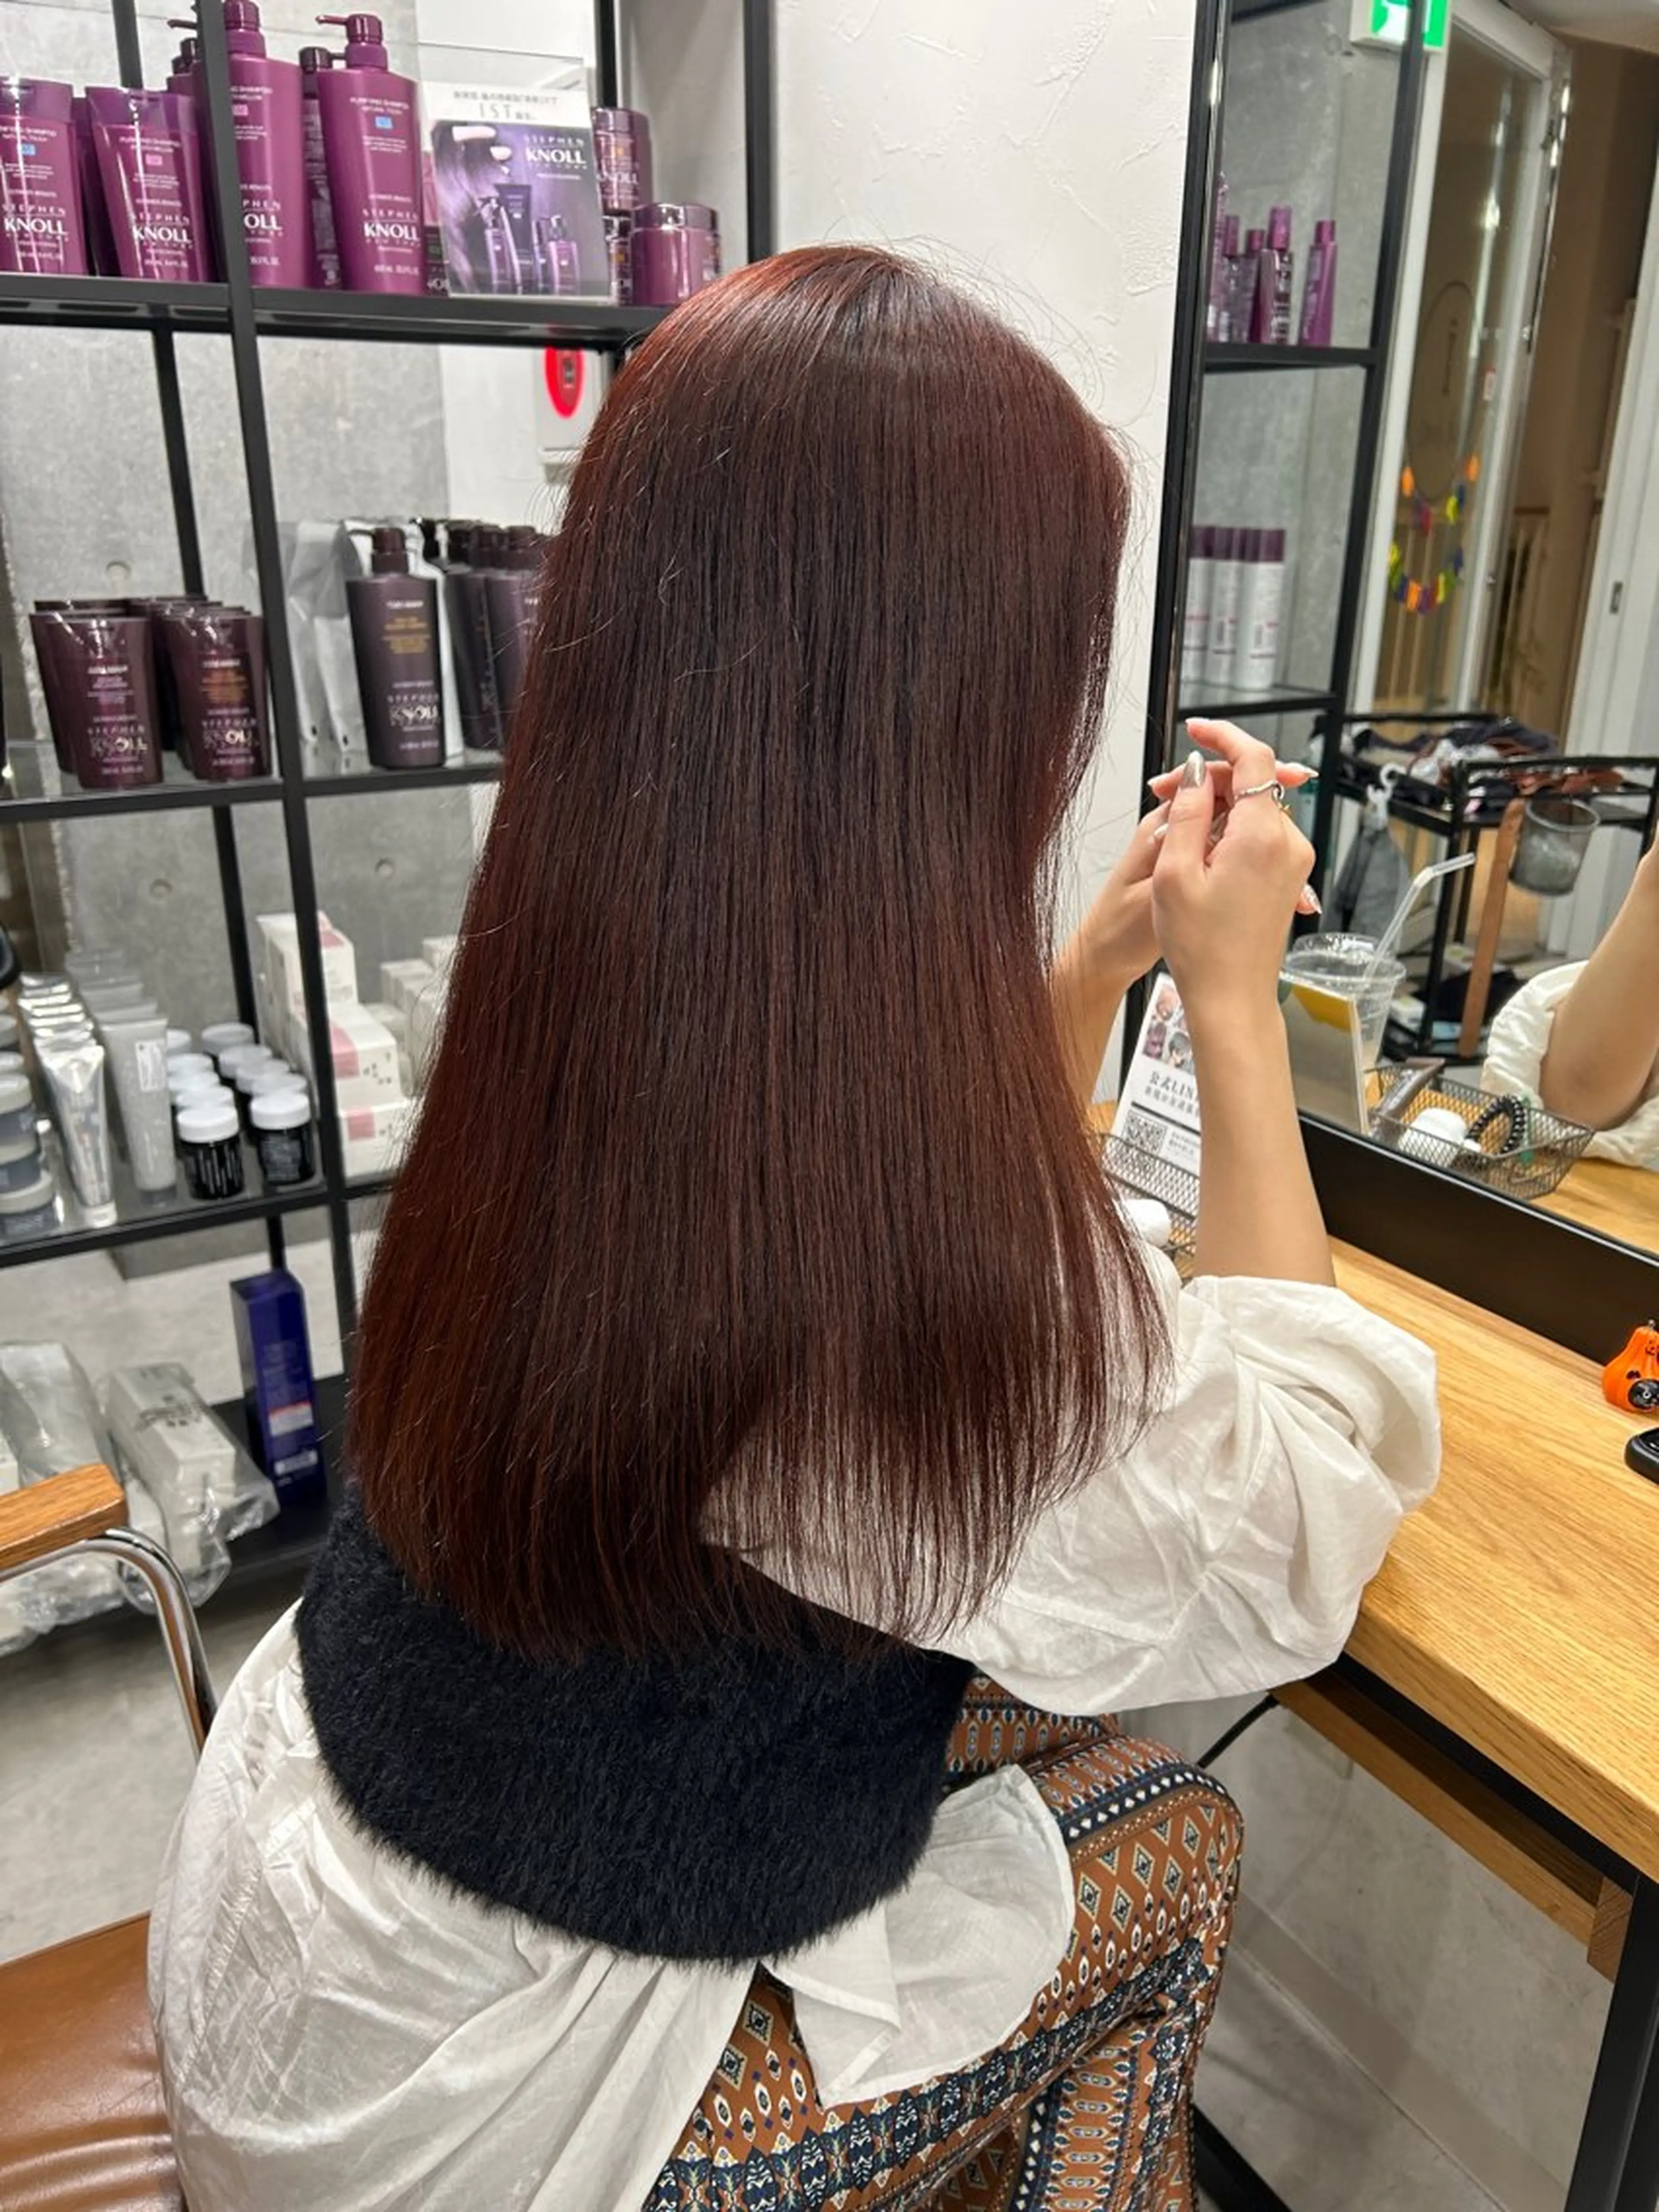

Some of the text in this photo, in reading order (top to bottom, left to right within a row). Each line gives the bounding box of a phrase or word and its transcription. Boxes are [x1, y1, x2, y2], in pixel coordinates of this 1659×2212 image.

[525, 147, 588, 165] KNOLL
[4, 217, 70, 236] KNOLL
[243, 213, 284, 231] OLL
[132, 225, 192, 244] KNOLL
[364, 222, 422, 242] KNOLL
[1149, 1071, 1196, 1102] 公式LIN
